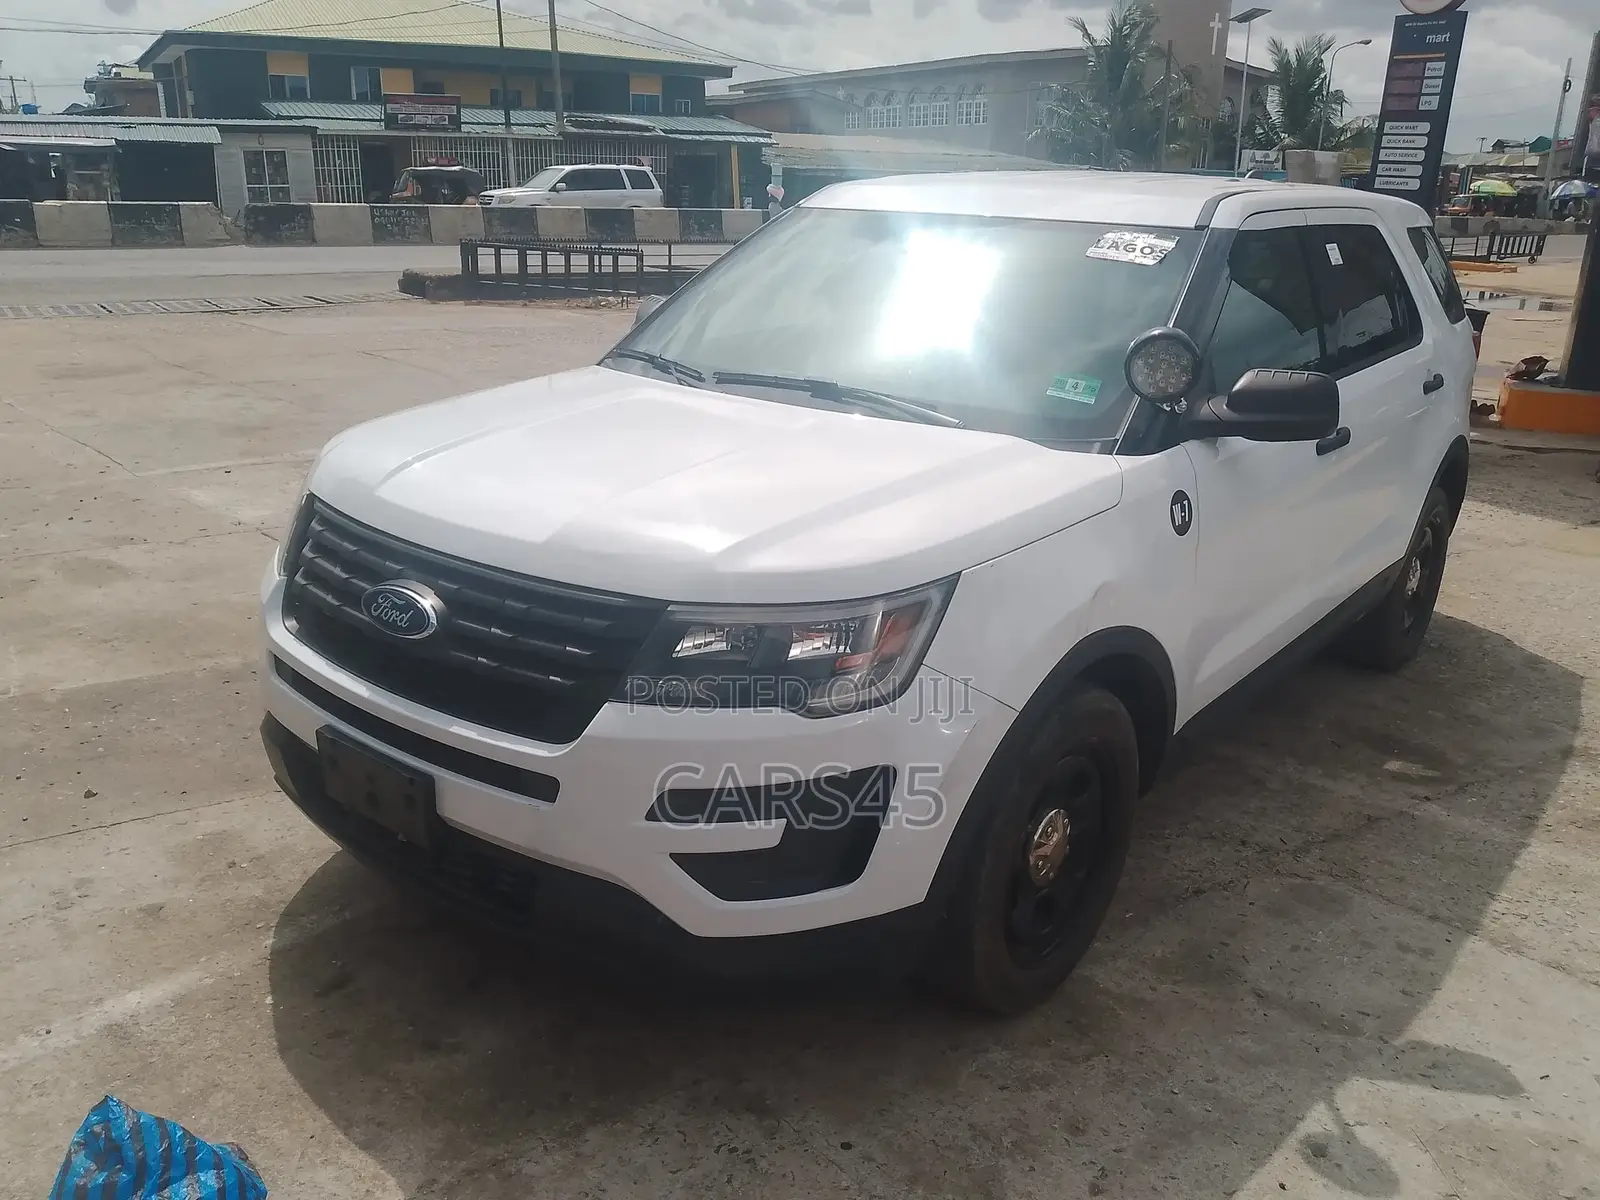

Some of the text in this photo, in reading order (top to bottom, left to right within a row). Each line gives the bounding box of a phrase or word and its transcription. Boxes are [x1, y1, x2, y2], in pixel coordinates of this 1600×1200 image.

[1426, 32, 1450, 43] mart
[1072, 381, 1080, 391] 4
[371, 593, 414, 628] Ford
